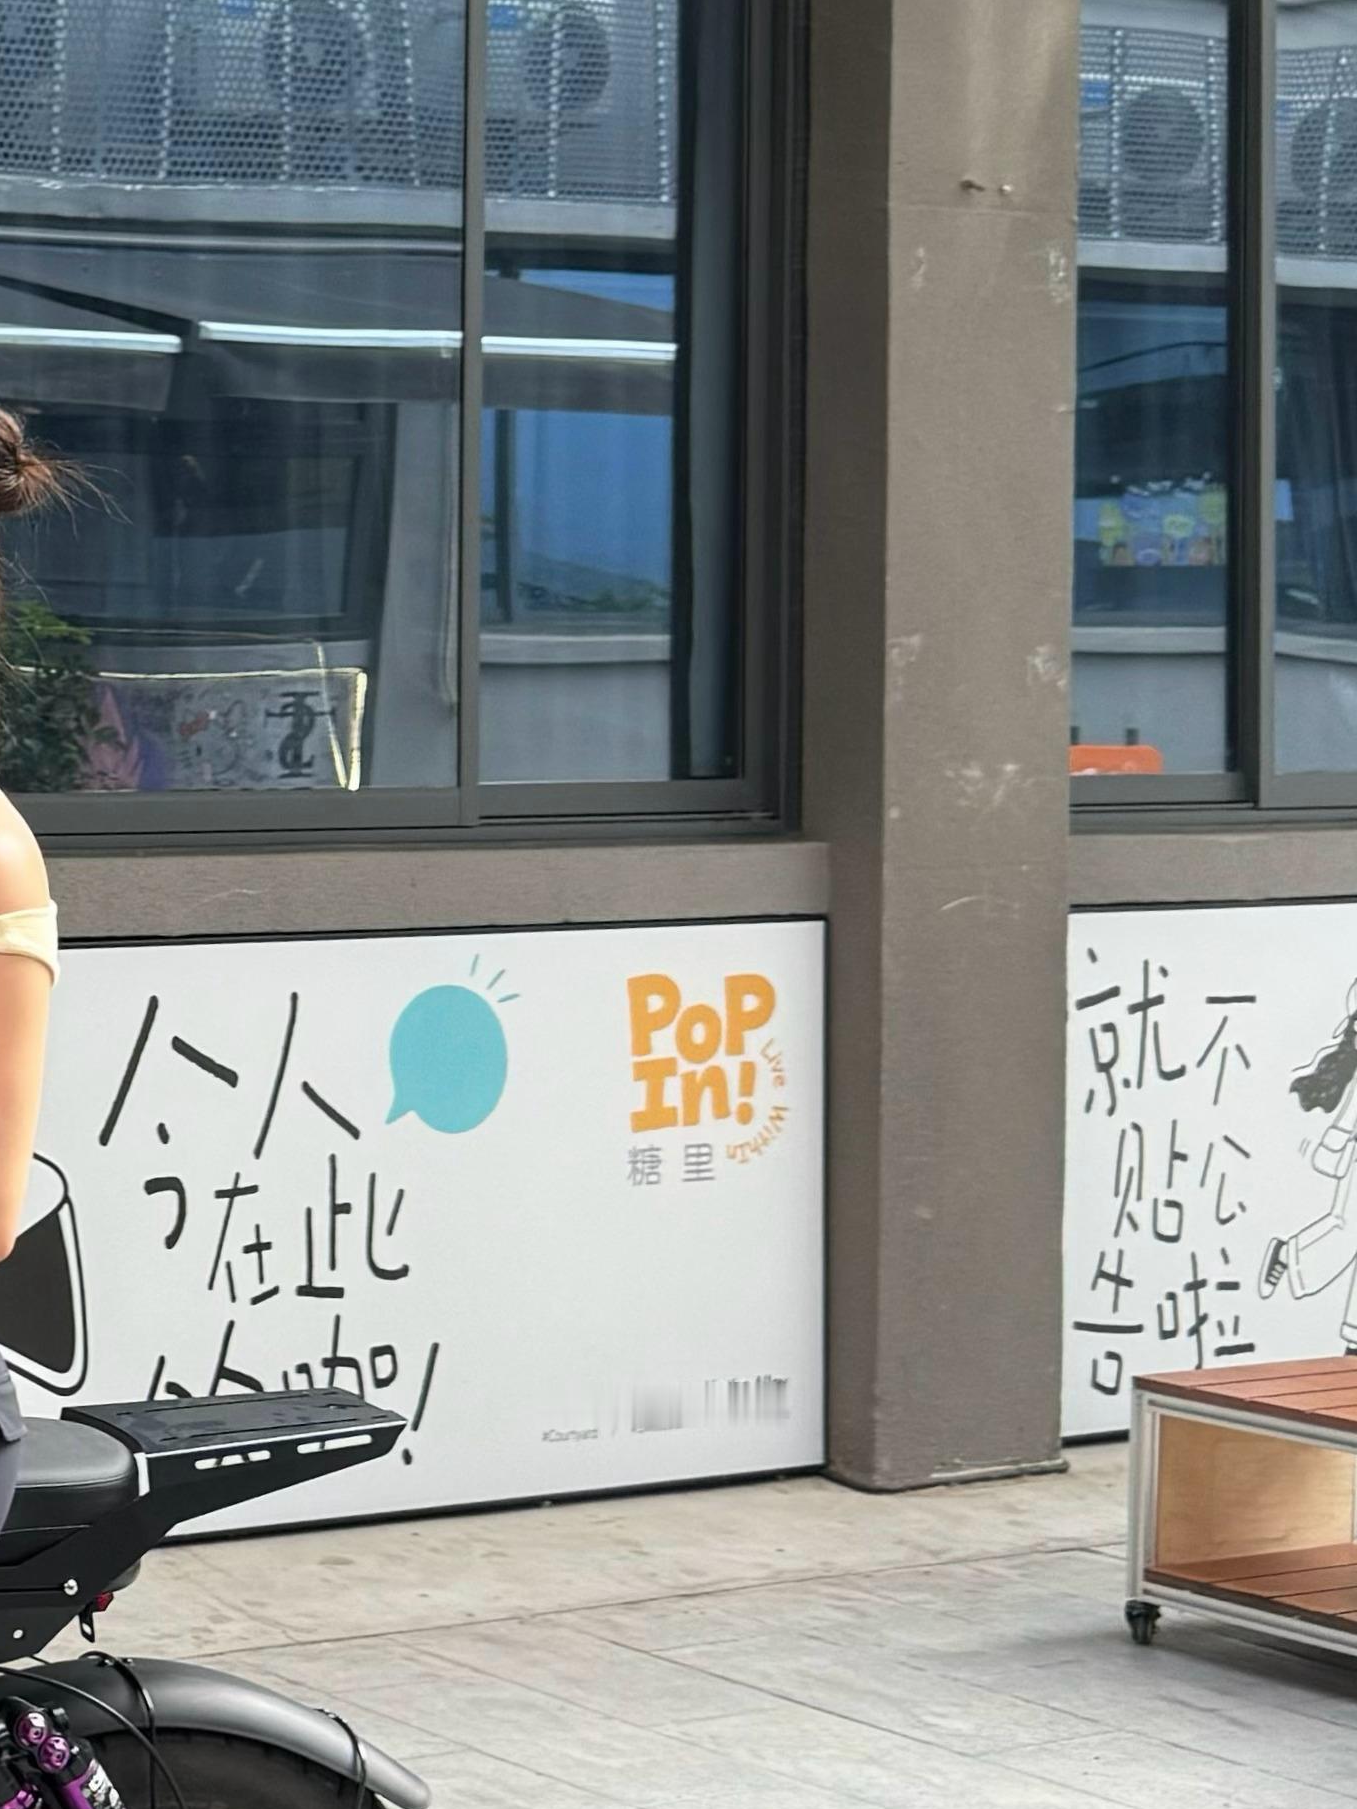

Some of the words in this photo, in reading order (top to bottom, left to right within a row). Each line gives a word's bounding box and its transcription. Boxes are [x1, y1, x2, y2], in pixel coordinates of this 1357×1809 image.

[629, 1057, 757, 1134] In!
[1075, 947, 1257, 1117] 就不
[207, 1152, 410, 1307] 在此
[626, 1141, 716, 1187] 糖里
[1072, 1245, 1256, 1397] 告啦
